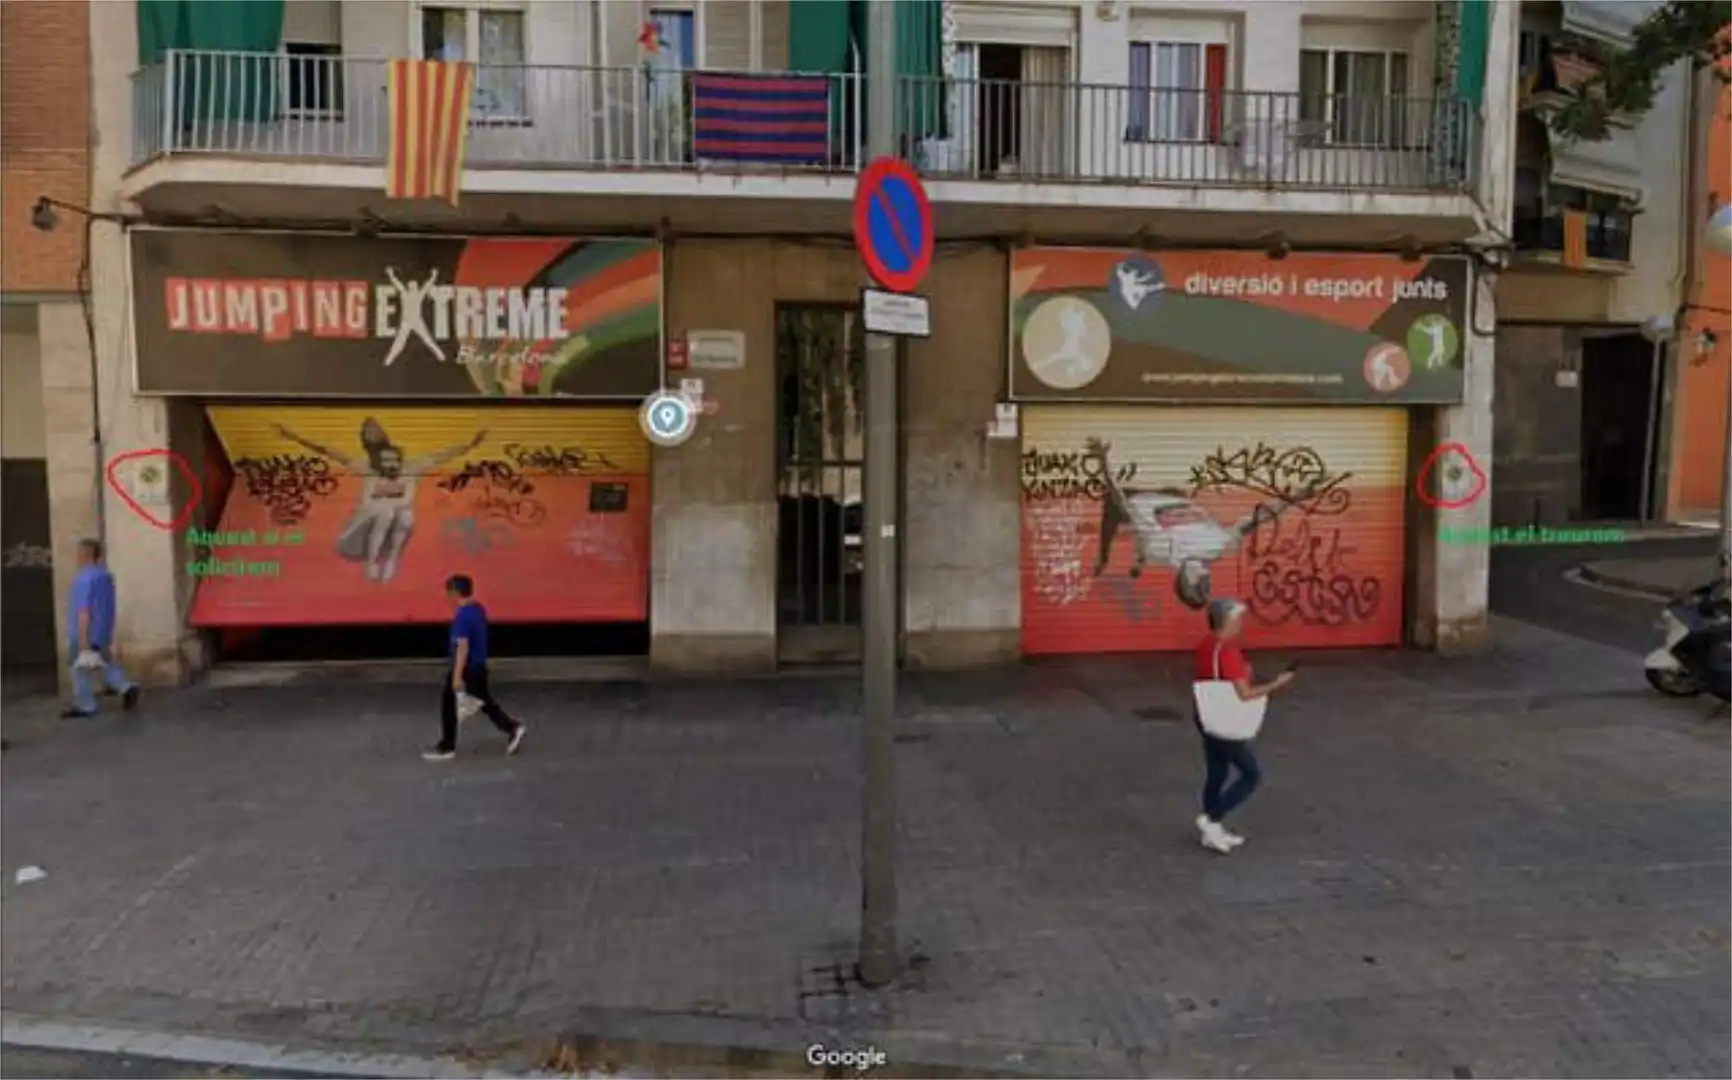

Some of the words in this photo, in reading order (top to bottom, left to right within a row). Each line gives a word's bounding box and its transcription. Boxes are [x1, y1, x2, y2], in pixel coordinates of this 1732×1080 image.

[168, 281, 368, 332] JUMPING
[375, 267, 569, 366] EXTREME
[1184, 271, 1284, 295] diversió
[1290, 275, 1298, 294] i
[1303, 276, 1384, 302] esport
[1391, 277, 1448, 303] junts
